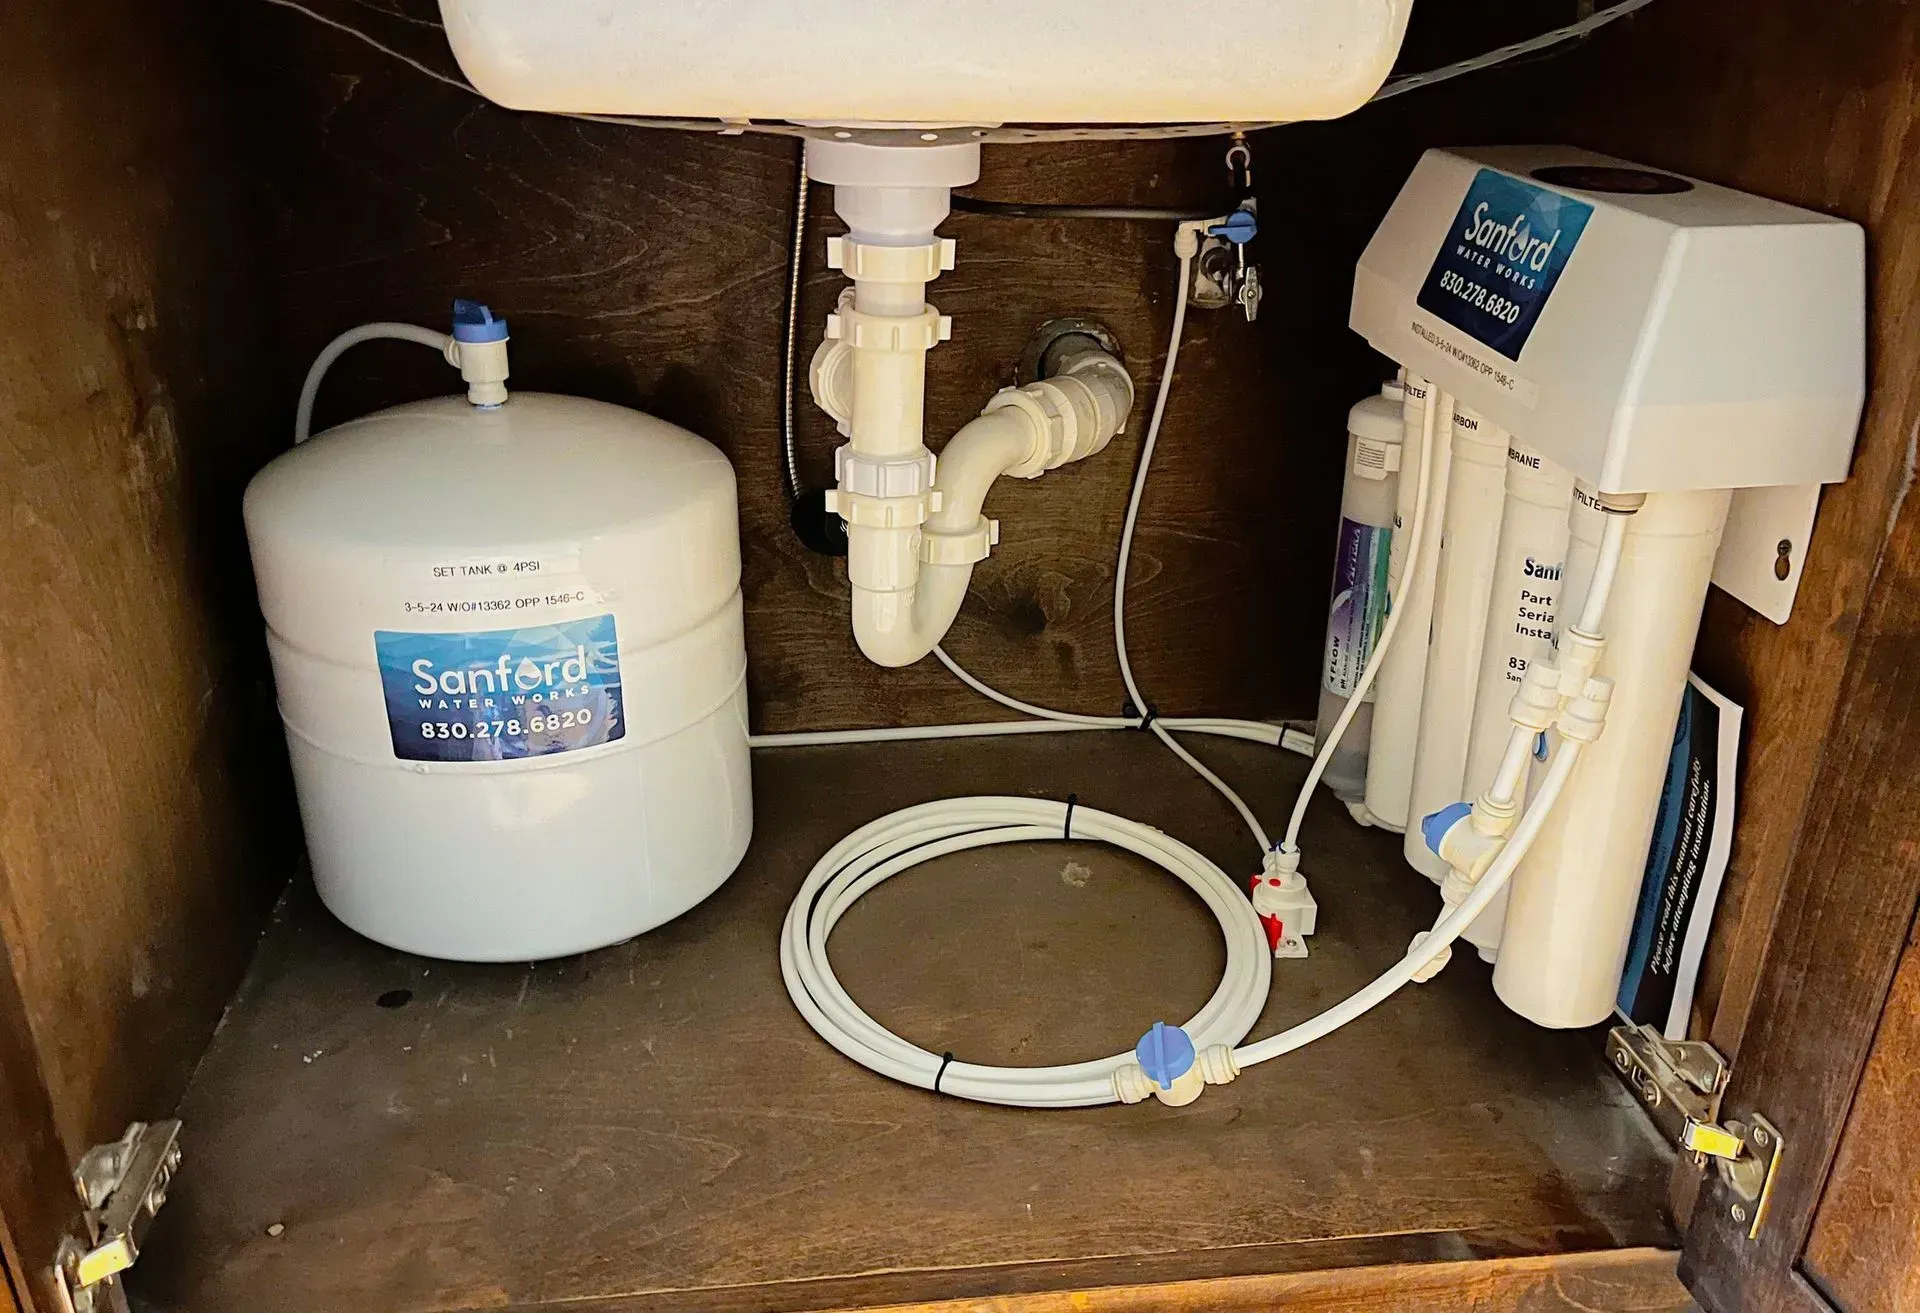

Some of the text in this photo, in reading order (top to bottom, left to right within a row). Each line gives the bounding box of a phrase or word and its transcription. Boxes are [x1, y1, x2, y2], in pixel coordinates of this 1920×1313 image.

[1464, 201, 1561, 272] Sanford
[1456, 245, 1536, 290] WATER WORKS
[1440, 270, 1520, 324] 830.278.6820
[1480, 362, 1493, 376] OPP
[433, 561, 540, 577] SET TANK @ 4PSI
[1524, 556, 1563, 581] Sanf
[404, 602, 443, 613] 3-5-24
[515, 597, 540, 608] OPP
[545, 591, 585, 605] 1546-C
[1521, 590, 1552, 606] Part
[1332, 636, 1341, 673] FLOW
[1508, 656, 1528, 671] 83
[411, 645, 587, 695] Sanford
[418, 685, 590, 709] WATER WORKS
[1340, 679, 1347, 689] pH
[421, 709, 592, 739] 830.278.6820
[1650, 756, 1702, 975] Please read this manual carefully
[1662, 779, 1710, 975] before attempting installation.
